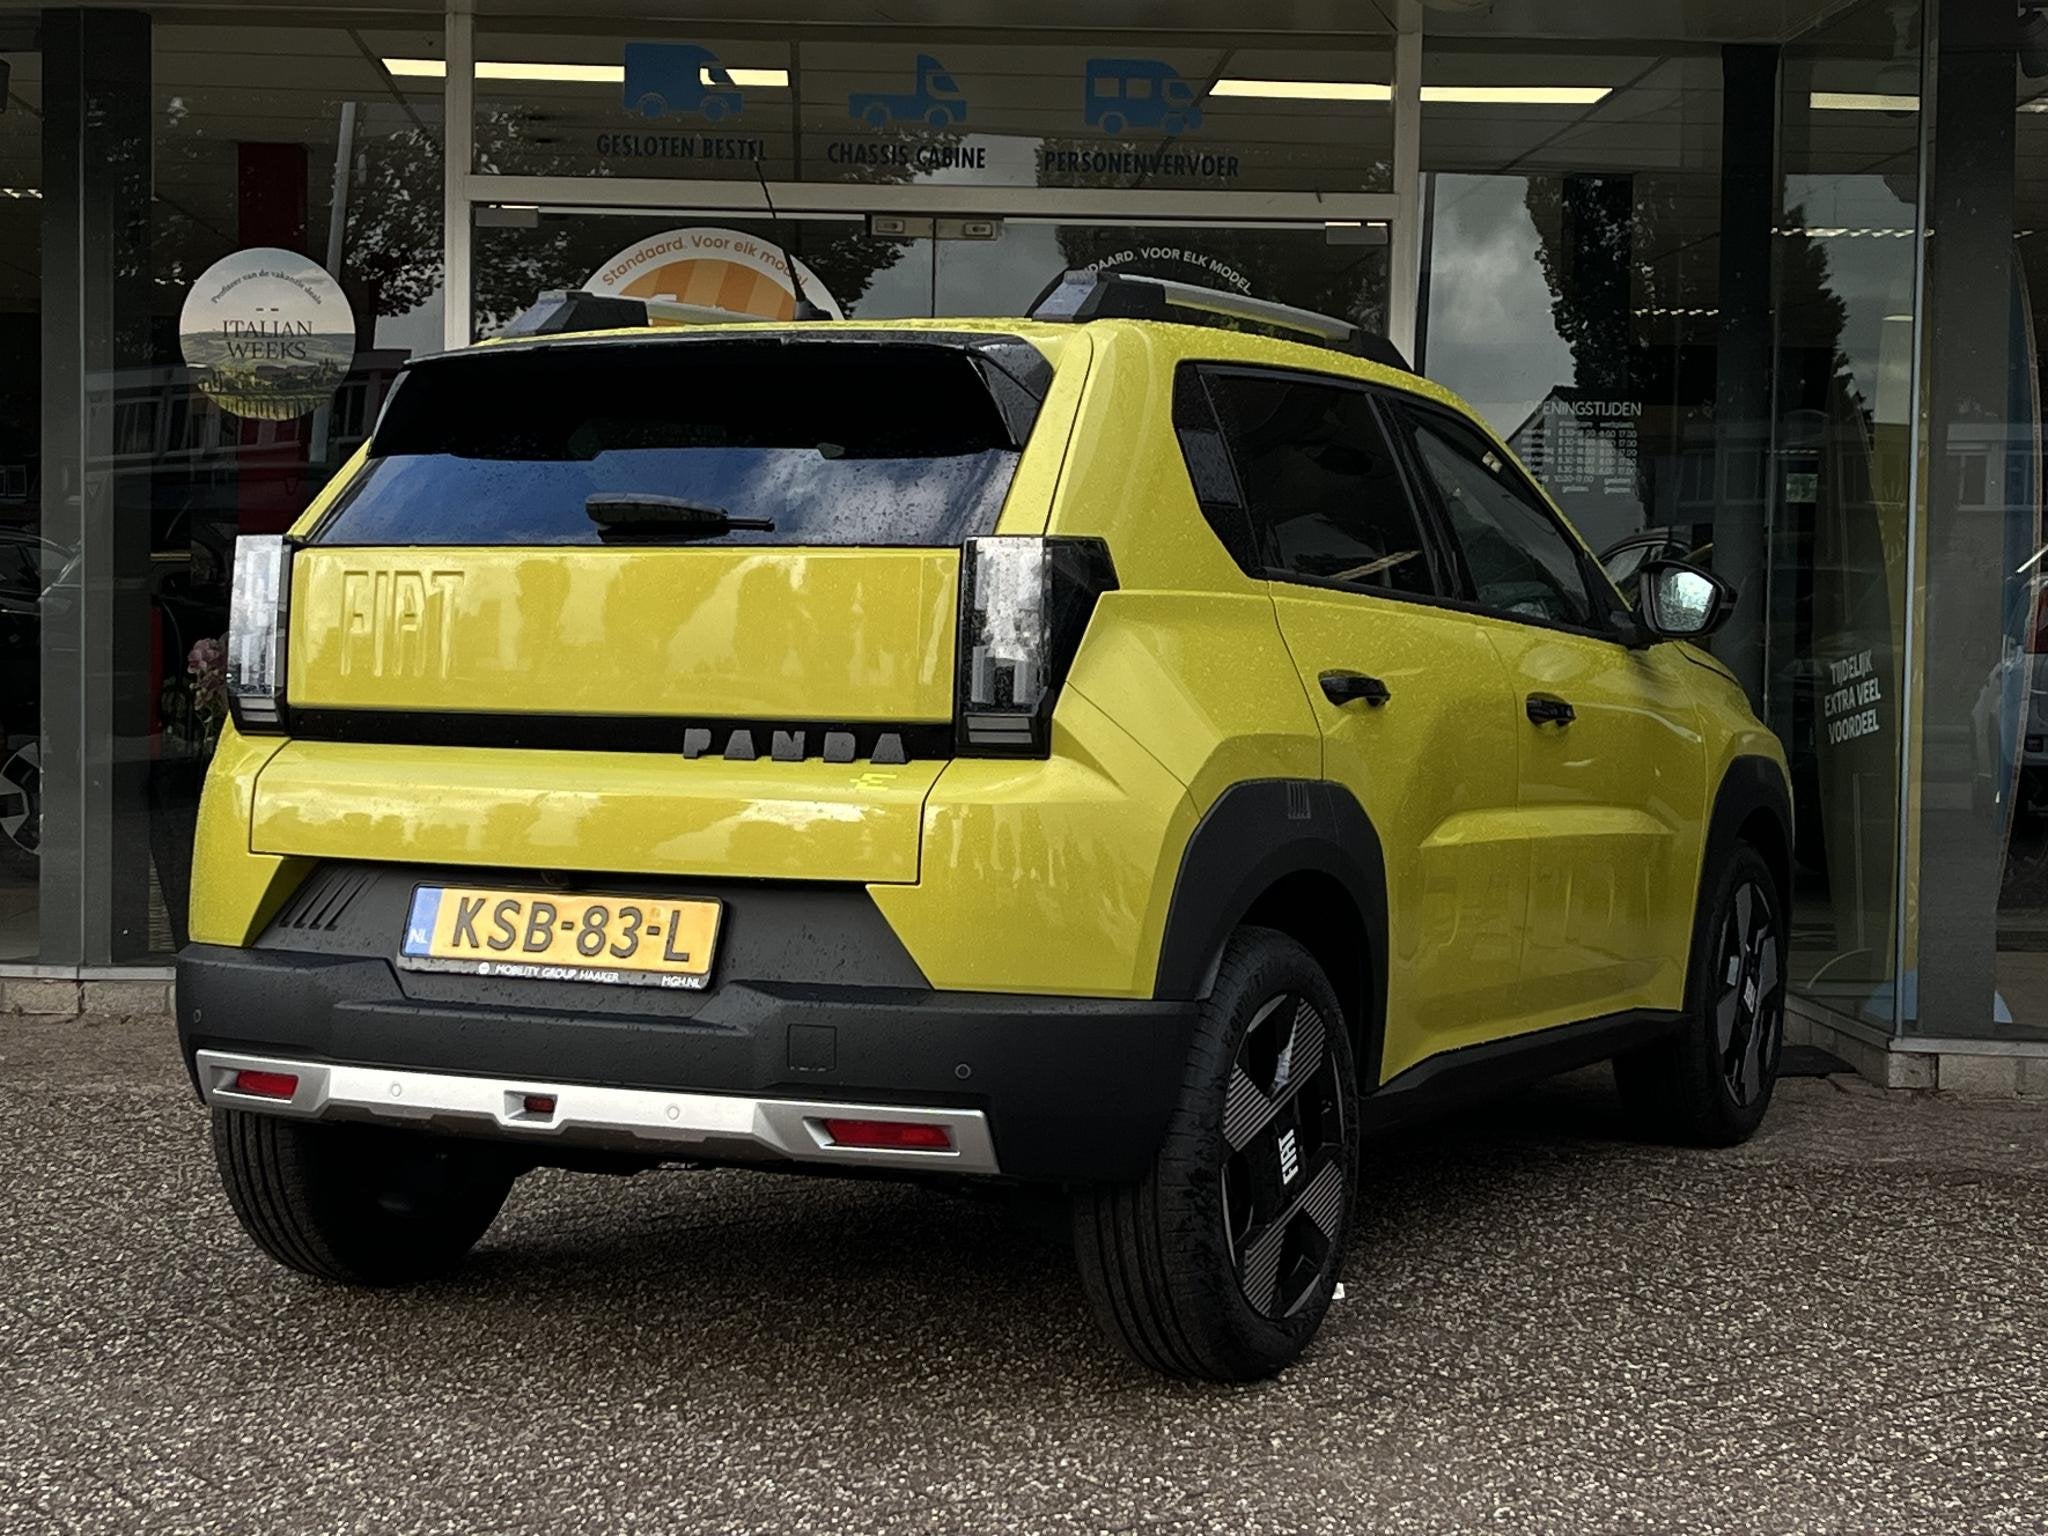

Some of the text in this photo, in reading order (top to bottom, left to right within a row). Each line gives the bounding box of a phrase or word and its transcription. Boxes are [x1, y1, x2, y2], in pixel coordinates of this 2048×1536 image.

[597, 134, 769, 161] GESLOTEN BESTEL
[827, 142, 986, 169] CHASSIS CABINE
[1044, 150, 1240, 178] PERSONENVERVOER
[691, 234, 730, 250] Voor
[735, 240, 758, 256] elk
[1141, 247, 1180, 259] VOOR
[1183, 251, 1208, 268] ELK
[242, 272, 257, 281] van
[259, 269, 269, 277] de
[222, 320, 313, 338] ITALIAN
[227, 341, 307, 360] WEEKS
[340, 570, 465, 679] FIAT
[1829, 648, 1873, 686] TIJDELIJK
[1824, 677, 1881, 718] EXTRA VEEL
[1828, 709, 1880, 745] VOORDEEL
[683, 728, 907, 764] PANDA
[407, 927, 428, 945] NL
[452, 897, 690, 962] KSB-83-L
[495, 963, 541, 978] MOBILITY
[542, 967, 577, 981] GROUP
[580, 970, 619, 984] HAAKER
[1278, 1128, 1299, 1185] FIAT
